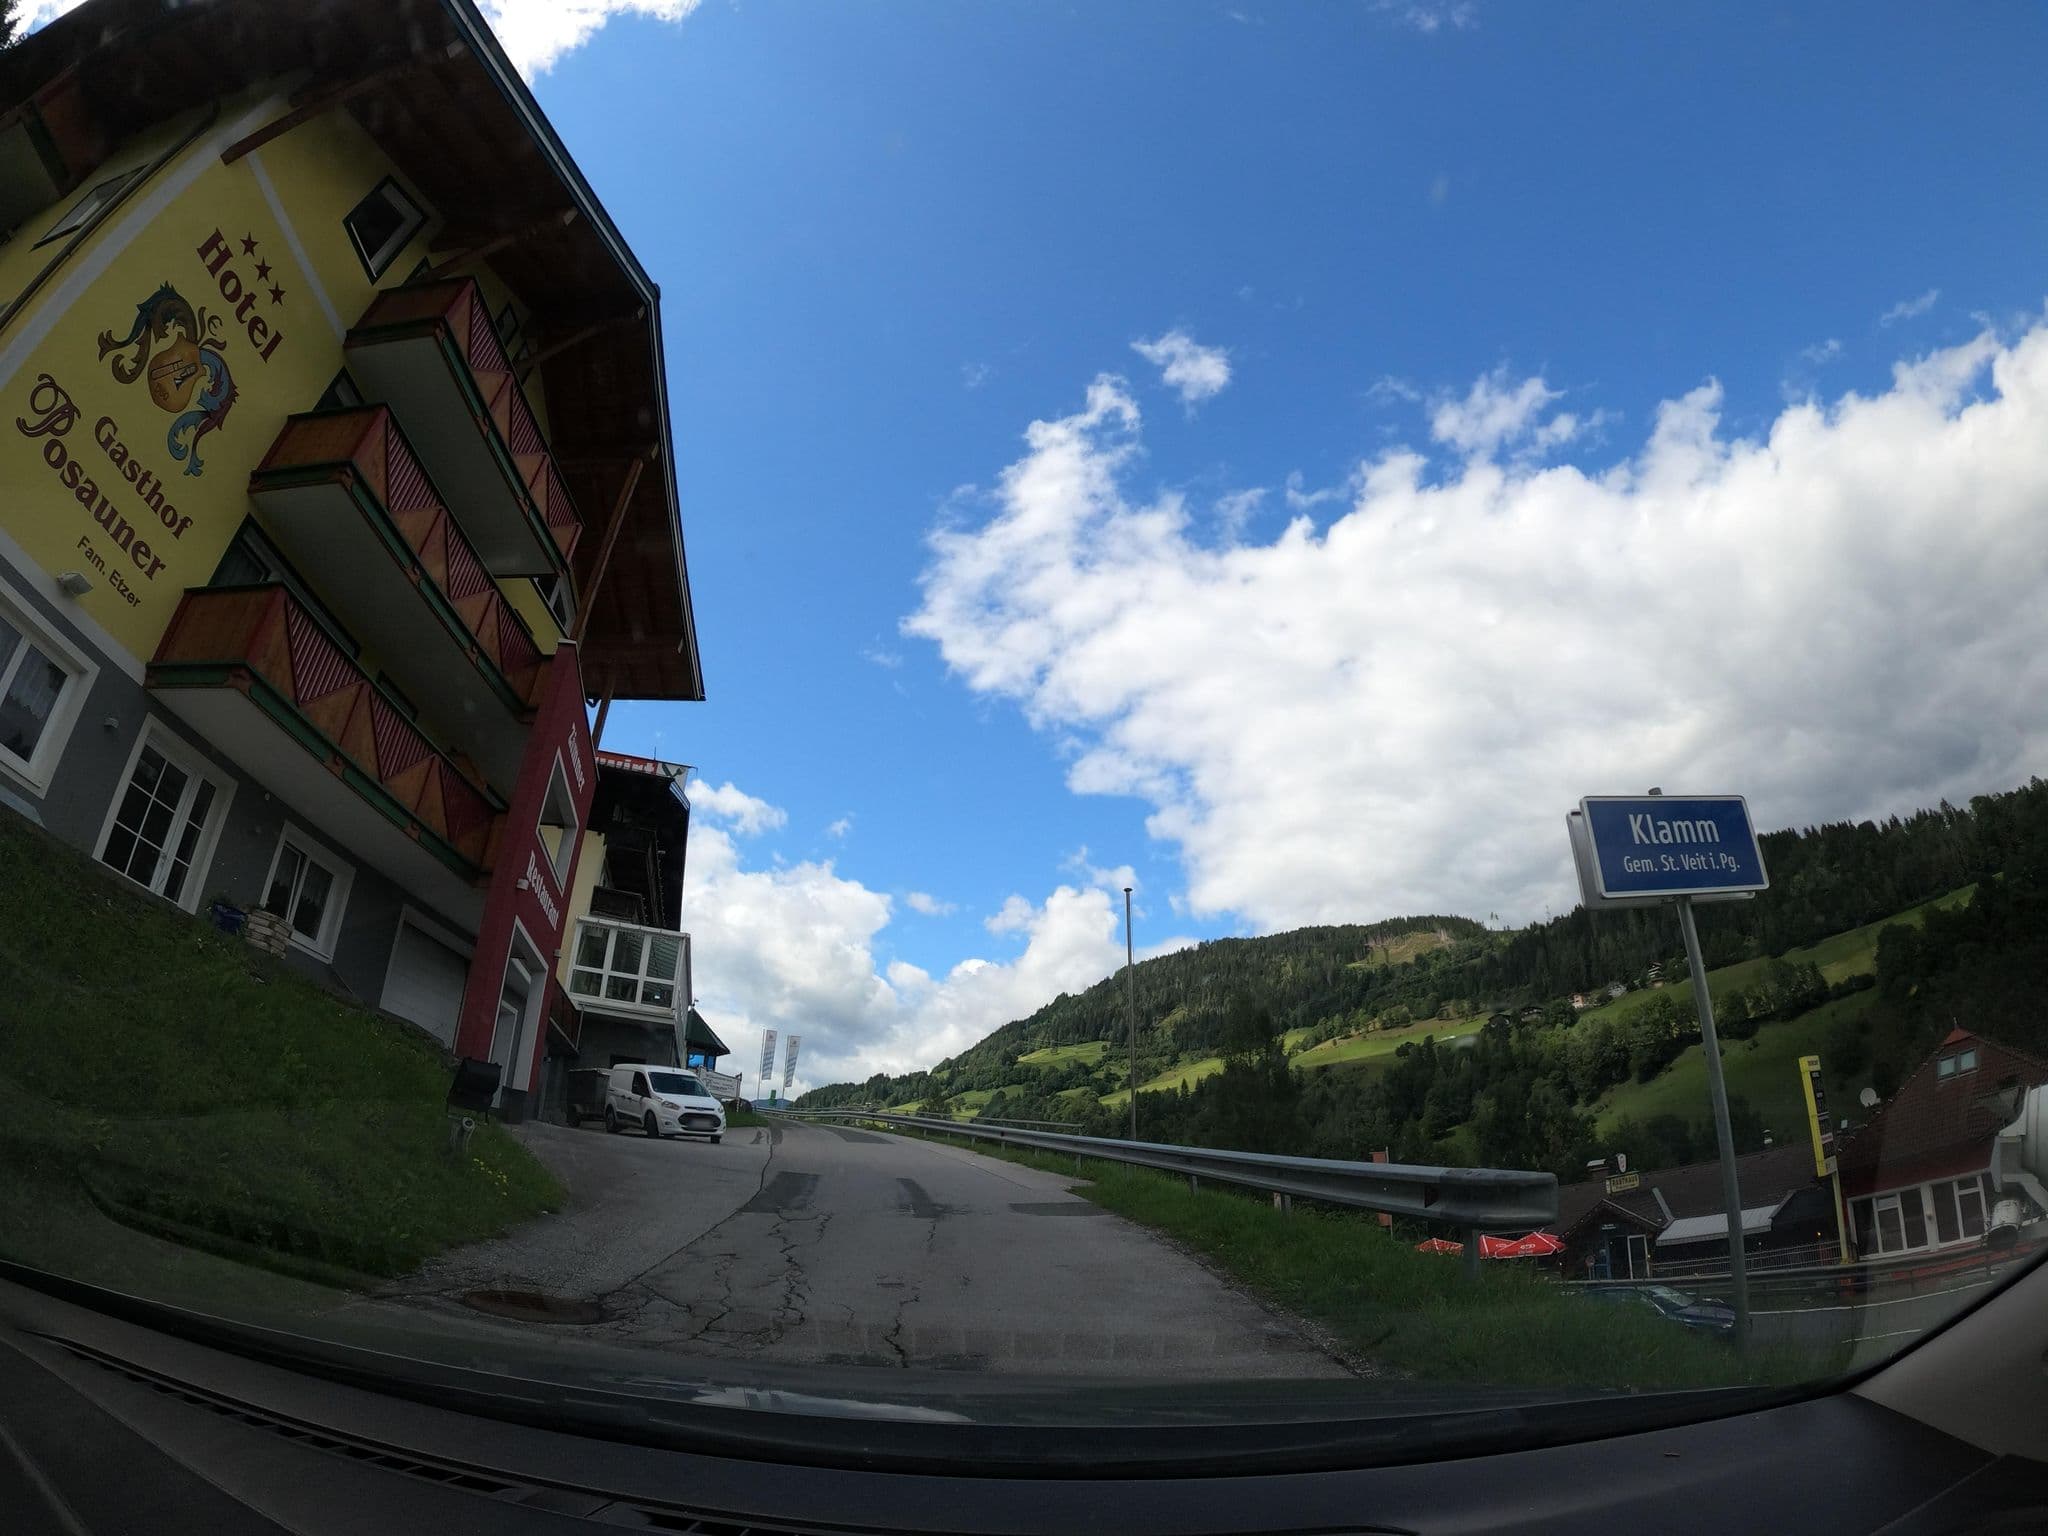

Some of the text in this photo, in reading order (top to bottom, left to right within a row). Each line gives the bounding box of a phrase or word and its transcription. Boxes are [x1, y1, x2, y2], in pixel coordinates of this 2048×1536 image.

[196, 227, 284, 363] Hotel
[16, 373, 167, 581] Posauner
[94, 416, 194, 540] Gasthof
[76, 535, 142, 609] Fam. Etzer
[568, 721, 585, 795] Zimmer
[1623, 852, 1741, 873] Gem. St. Veit i. Pg.
[1628, 813, 1721, 845] Klamm
[526, 849, 560, 932] Restaurant
